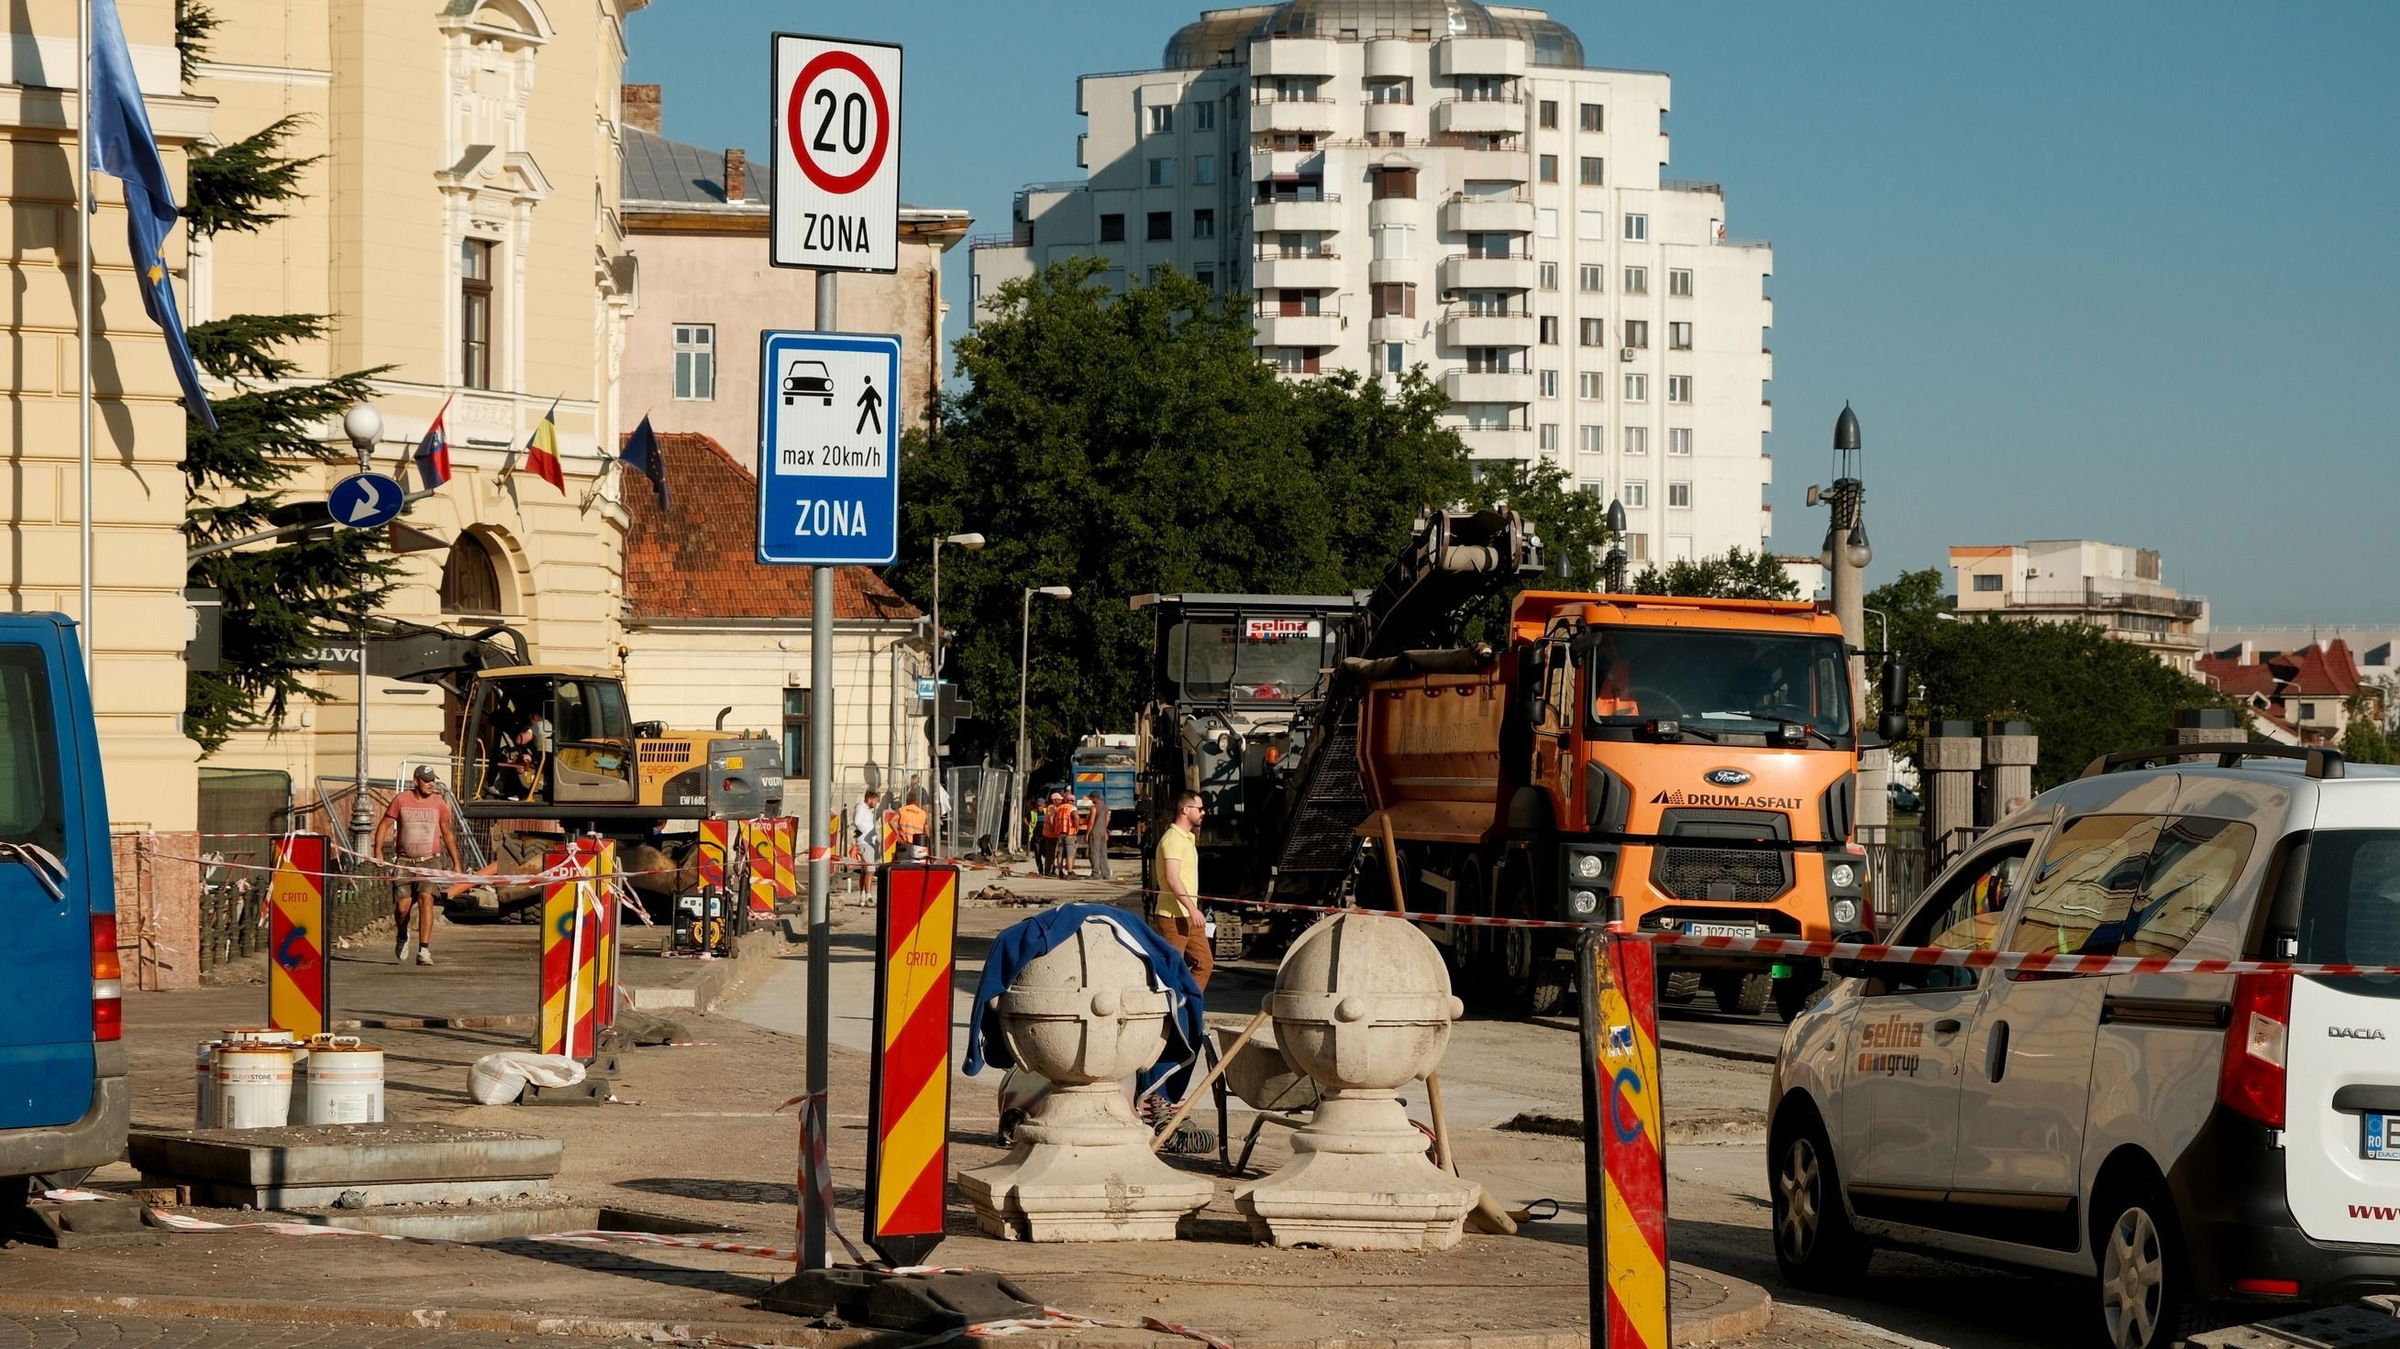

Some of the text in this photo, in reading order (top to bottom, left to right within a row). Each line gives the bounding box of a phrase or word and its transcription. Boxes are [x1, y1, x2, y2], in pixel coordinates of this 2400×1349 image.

[813, 88, 867, 155] 20
[803, 213, 870, 254] ZONA
[783, 445, 881, 467] max 20km/h
[794, 499, 867, 537] ZONA
[1251, 619, 1308, 631] selina
[1278, 632, 1308, 640] grup
[1715, 770, 1741, 783] Ford
[1687, 793, 1803, 809] DRUM-ASFALT
[282, 892, 308, 902] CRITO
[906, 951, 938, 967] CRITO
[1861, 1014, 1924, 1048] selina
[2328, 1026, 2386, 1040] DACIA
[1887, 1054, 1920, 1077] grup
[2368, 1135, 2382, 1148] RO
